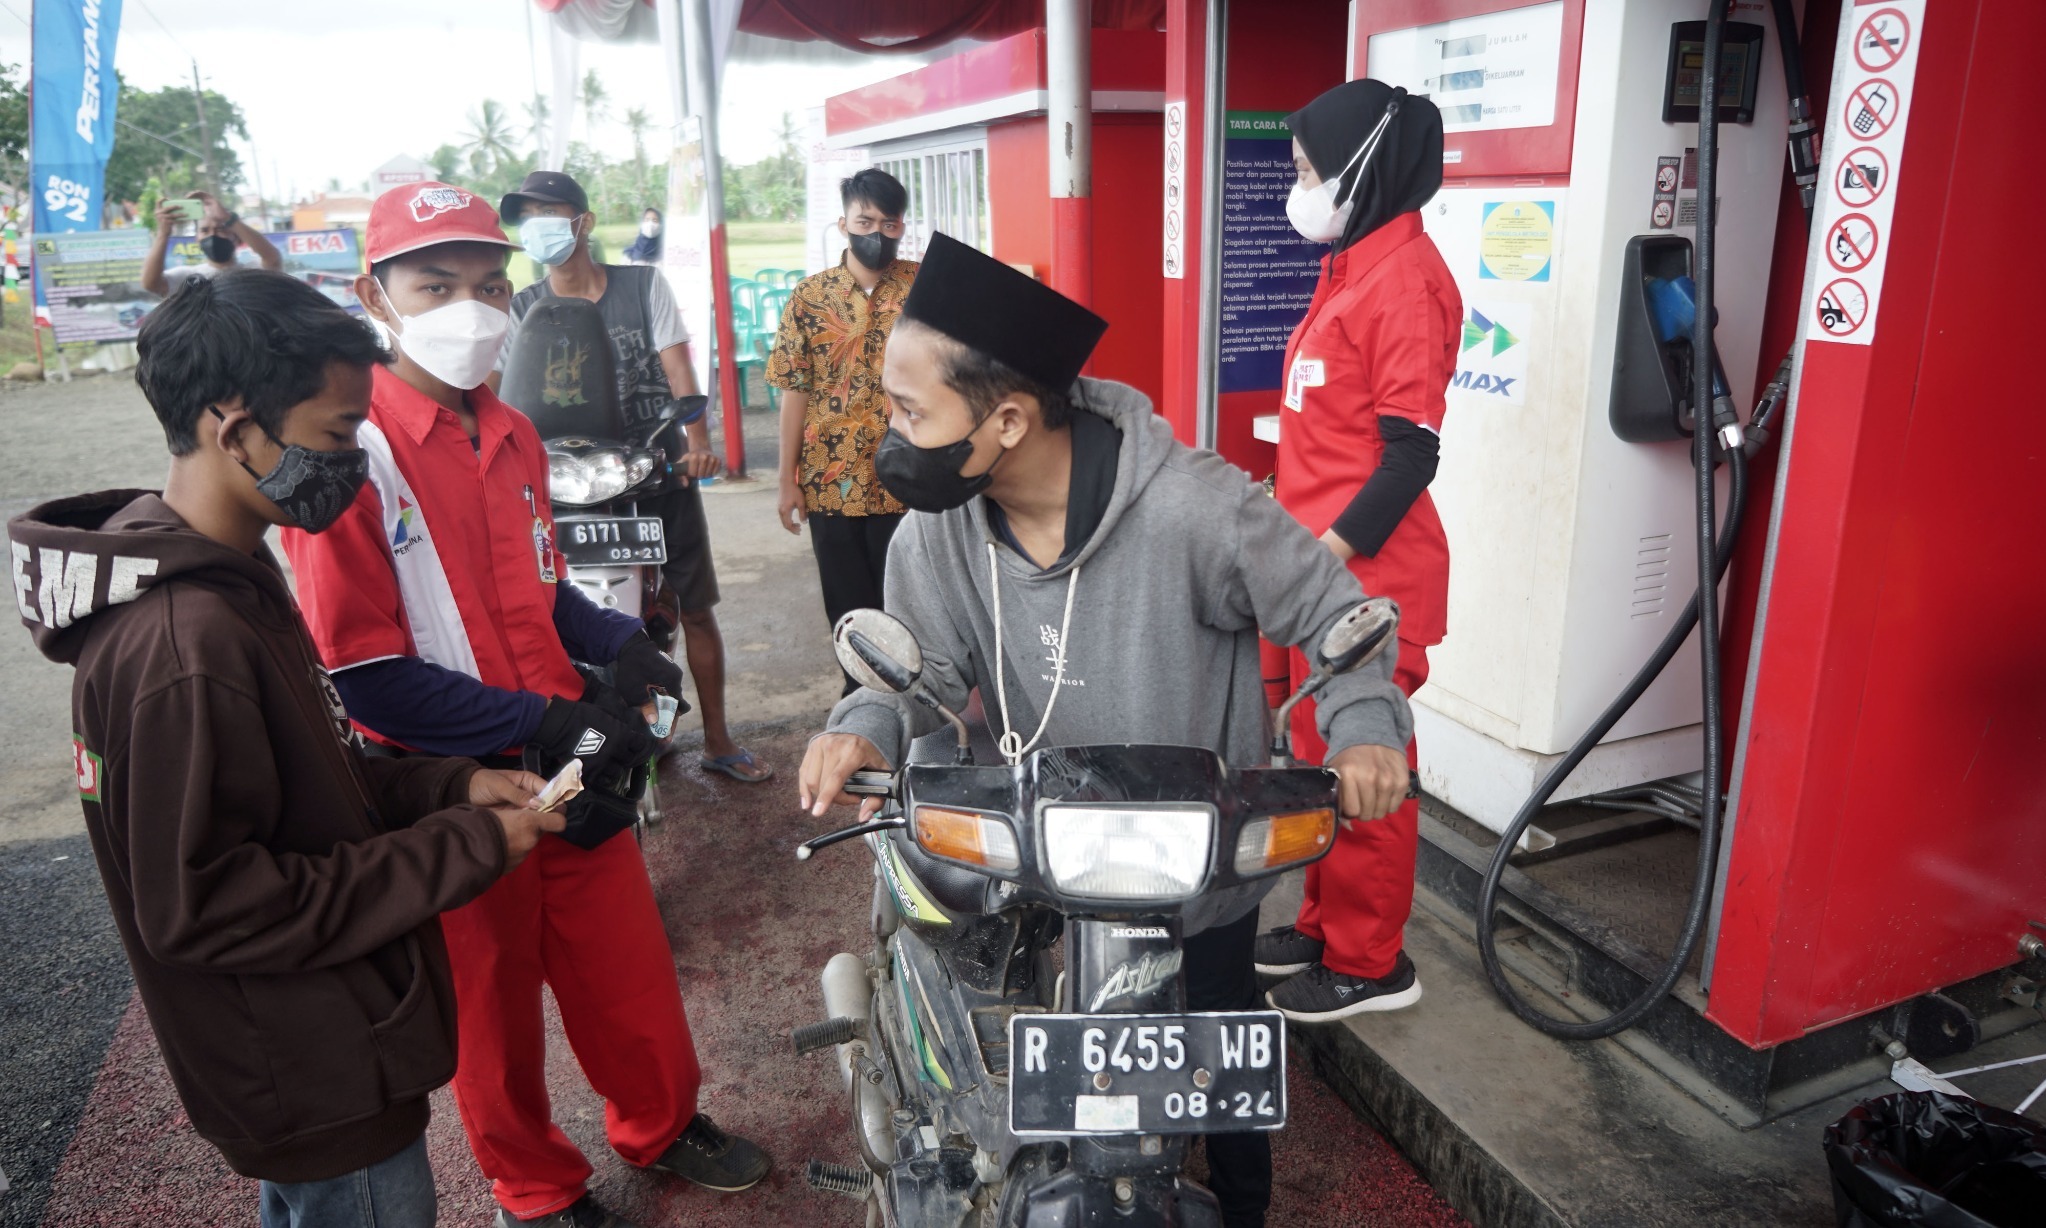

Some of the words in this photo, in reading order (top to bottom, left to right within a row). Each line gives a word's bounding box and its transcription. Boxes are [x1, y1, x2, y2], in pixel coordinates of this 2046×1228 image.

[1488, 33, 1528, 46] JUMLAH
[1485, 70, 1524, 80] DIKELUARKAN
[1230, 120, 1251, 129] TATA
[1253, 121, 1277, 129] CARA
[48, 175, 89, 199] RON
[1226, 183, 1248, 191] Pasang
[1245, 193, 1264, 201] tangki
[45, 189, 88, 222] 92
[1226, 203, 1246, 211] tangki.
[1225, 225, 1249, 233] dengan
[1250, 224, 1286, 232] permintaan
[289, 234, 345, 254] EKA
[1225, 239, 1253, 247] Siagakan
[1249, 262, 1268, 270] proses
[1270, 261, 1306, 269] penerimaan
[1259, 271, 1293, 279] penyaluran
[1267, 293, 1286, 301] terjadi
[1246, 327, 1282, 335] penerimaan
[1222, 336, 1251, 344] peralatan
[1267, 335, 1282, 343] tutup
[1222, 346, 1258, 354] penerimaan
[1453, 369, 1517, 397] MAX
[575, 523, 620, 543] 6171
[638, 522, 661, 541] RB
[1041, 674, 1085, 686] WARIOR
[1111, 927, 1170, 938] HONDA
[1024, 1027, 1048, 1072] R
[1082, 1025, 1187, 1073] 6455
[1220, 1024, 1271, 1069] WB
